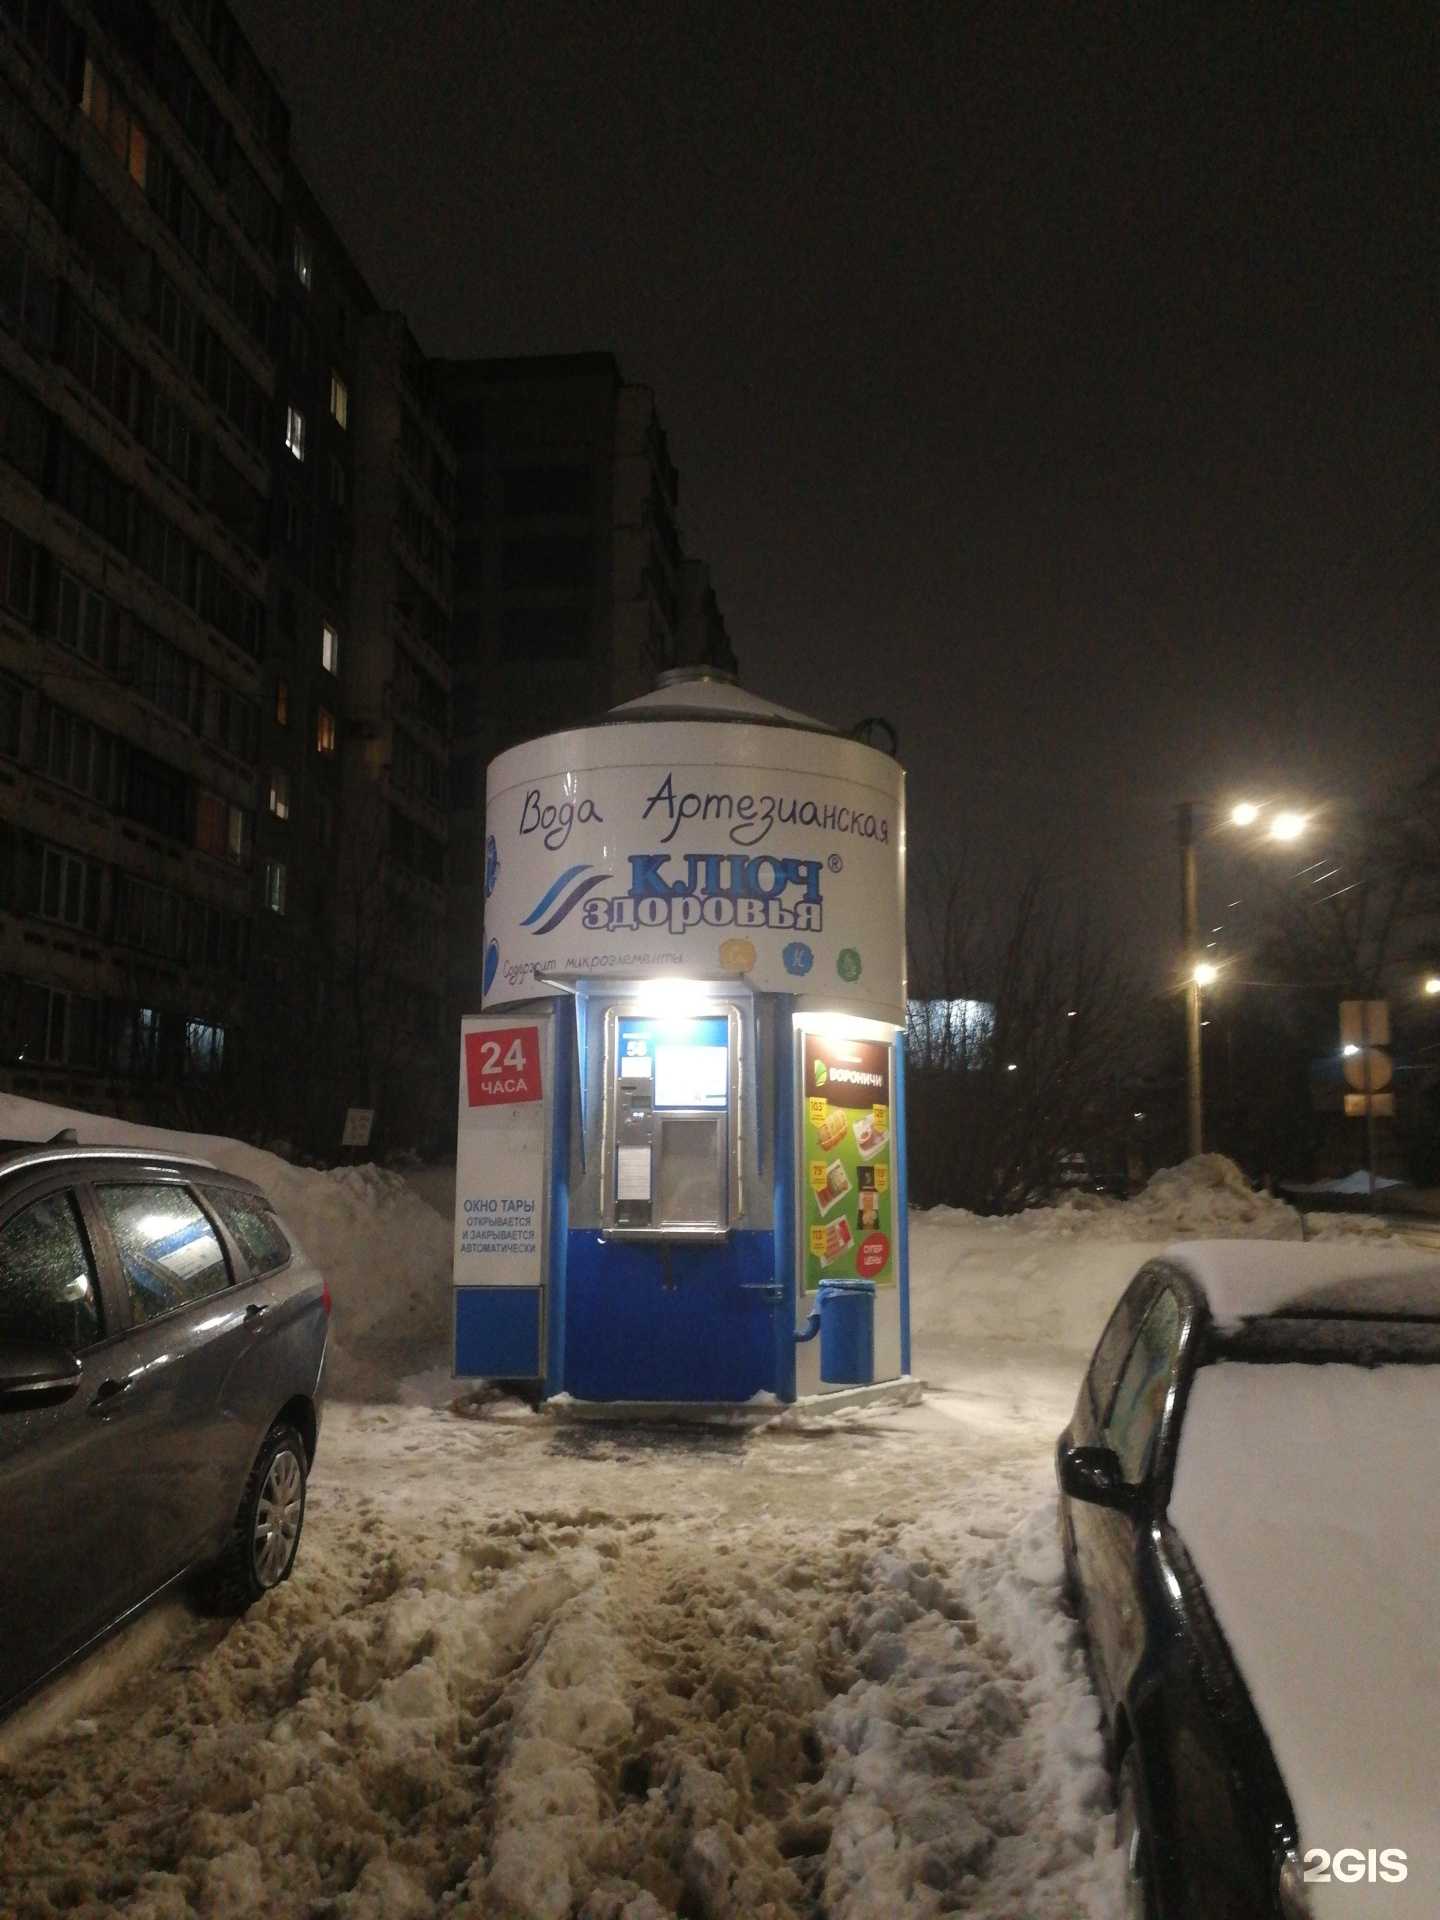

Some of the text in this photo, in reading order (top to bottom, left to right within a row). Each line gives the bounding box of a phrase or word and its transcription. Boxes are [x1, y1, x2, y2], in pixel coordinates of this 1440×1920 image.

[520, 772, 889, 850] Вода Артезианская
[627, 853, 823, 901] КЛЮЧ
[480, 1038, 526, 1075] 24
[481, 1078, 528, 1095] ЧАСА
[464, 1199, 534, 1213] ОКНО ТАРЫ
[466, 1216, 531, 1227] ОТКРЫВАЕТСЯ
[461, 1243, 536, 1254] АВТОМАТИЧЕСКИ
